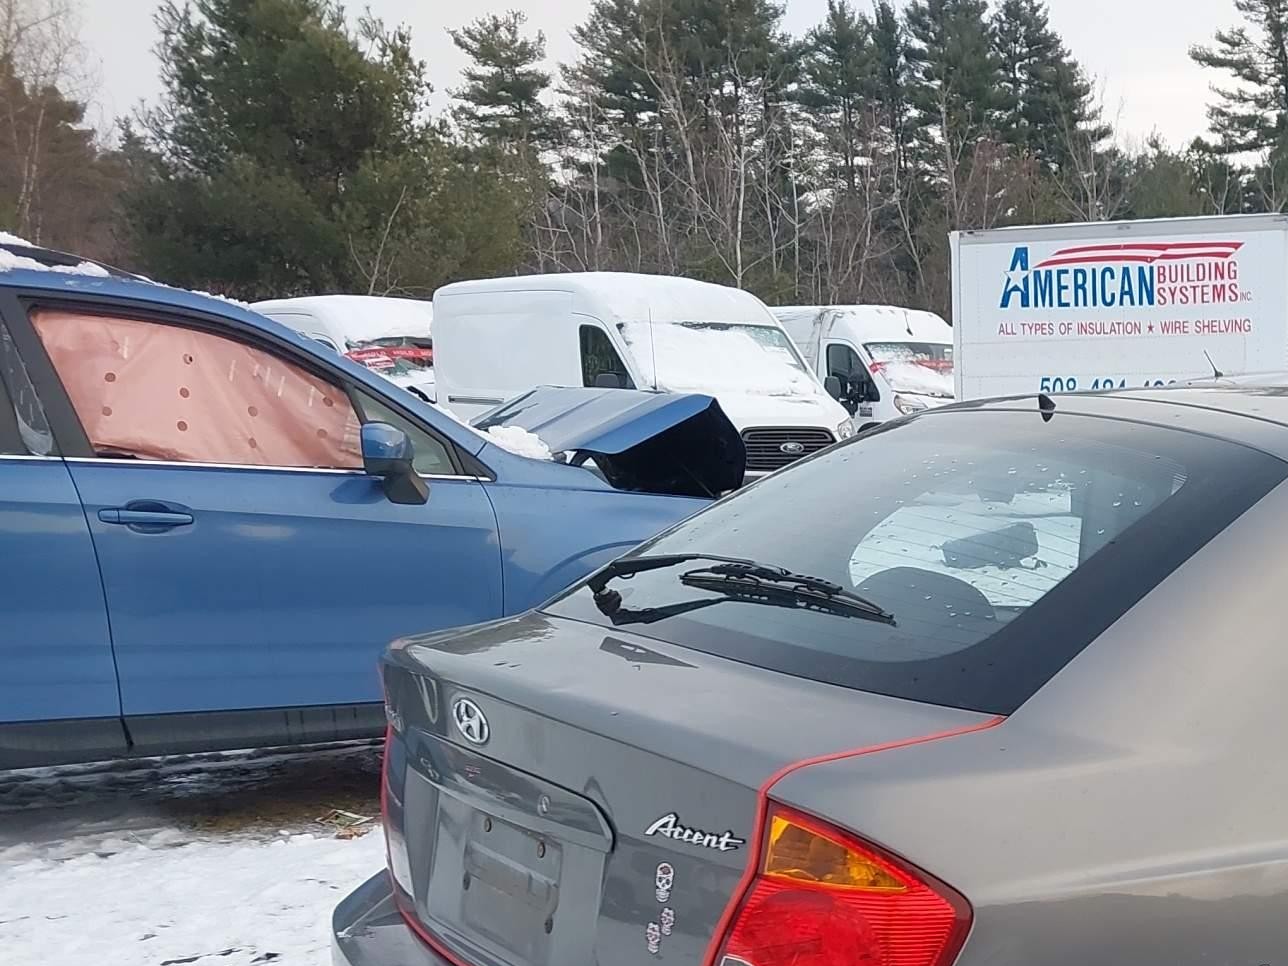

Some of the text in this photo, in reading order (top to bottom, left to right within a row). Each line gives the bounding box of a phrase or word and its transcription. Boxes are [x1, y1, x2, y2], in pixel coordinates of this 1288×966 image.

[999, 246, 1155, 308] AMERICAN
[1157, 260, 1238, 284] BUILDING
[1157, 283, 1239, 306] SYSTEMS
[998, 319, 1252, 336] ALL TYPES OF INSULATION WIRE SHELVING
[645, 812, 746, 851] Accent
